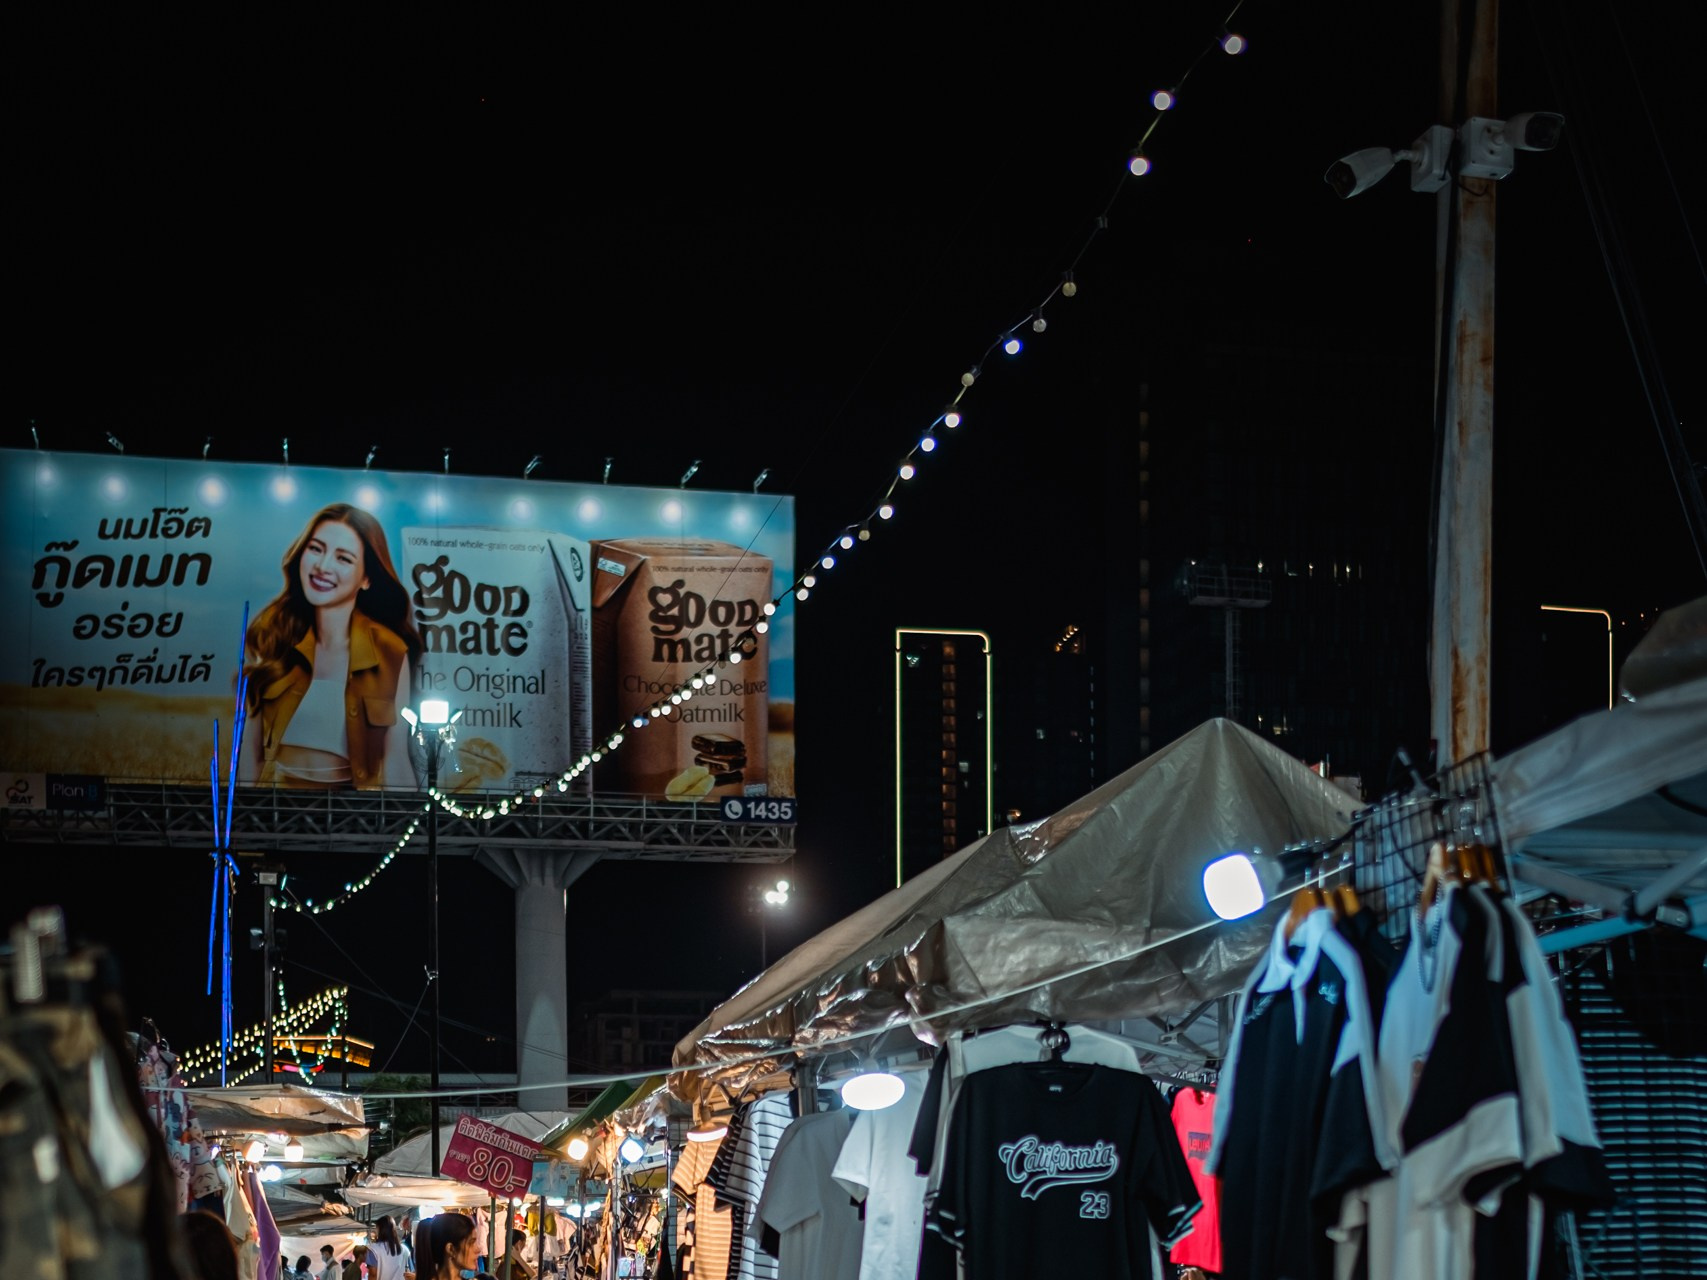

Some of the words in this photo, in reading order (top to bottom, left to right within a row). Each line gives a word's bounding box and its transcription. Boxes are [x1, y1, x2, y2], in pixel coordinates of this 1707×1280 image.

[98, 507, 212, 540] นมโอ๊ต
[32, 540, 212, 608] กู๊ดเมท
[73, 601, 183, 640] อร่อย
[32, 647, 215, 692] ใครๆก็ดื่มได้
[454, 665, 545, 699] Original
[719, 678, 767, 696] Deluxe
[52, 783, 84, 798] Plan
[747, 802, 792, 820] 1435
[999, 1134, 1119, 1200] California
[1079, 1190, 1111, 1219] 23
